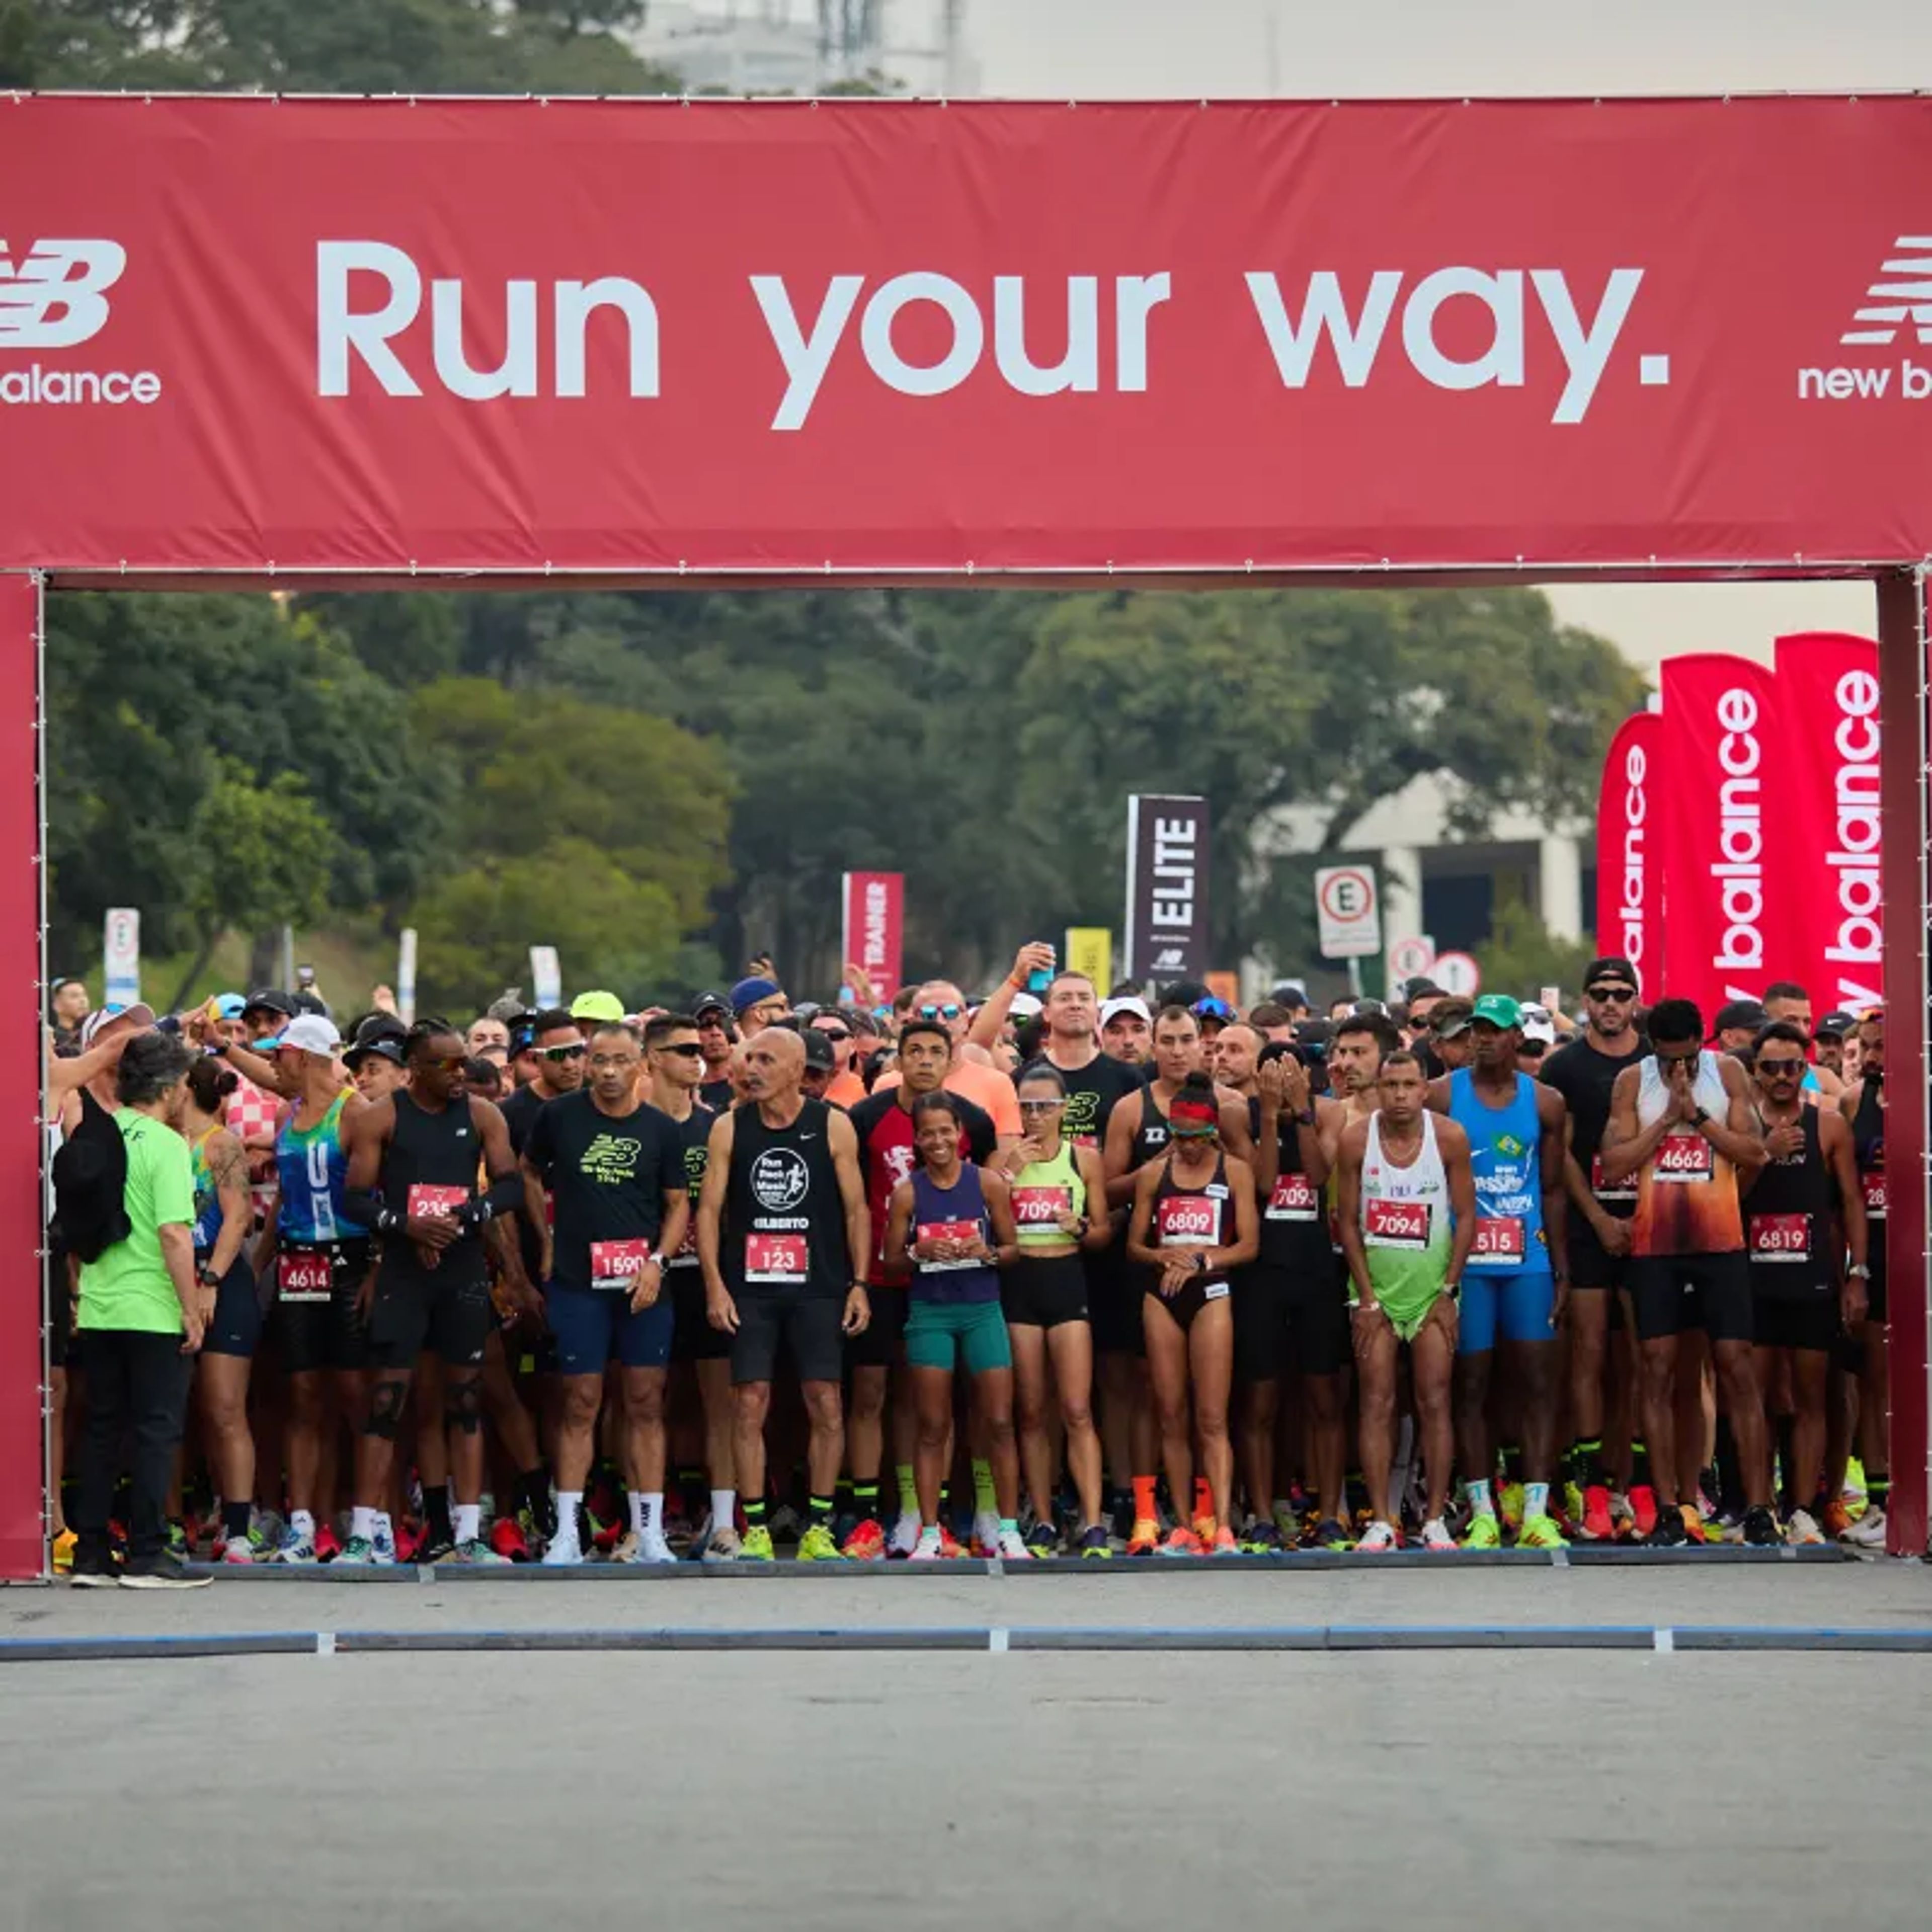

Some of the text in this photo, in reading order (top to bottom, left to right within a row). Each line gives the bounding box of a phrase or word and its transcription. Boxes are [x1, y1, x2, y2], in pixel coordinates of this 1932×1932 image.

[317, 240, 1669, 431] Run your way.
[0, 363, 161, 404] alance
[1797, 367, 1892, 399] new
[1825, 670, 1883, 962] balance
[1710, 688, 1763, 969] balance
[1152, 818, 1196, 926] ELITE
[1338, 883, 1354, 911] E
[1662, 1151, 1703, 1168] 4662
[1867, 1188, 1885, 1205] 28
[1166, 1213, 1210, 1230] 6809
[1376, 1215, 1421, 1234] 7094
[1477, 1233, 1511, 1250] 515
[1759, 1230, 1804, 1248] 6819
[762, 1251, 795, 1268] 123
[288, 1270, 328, 1287] 4614
